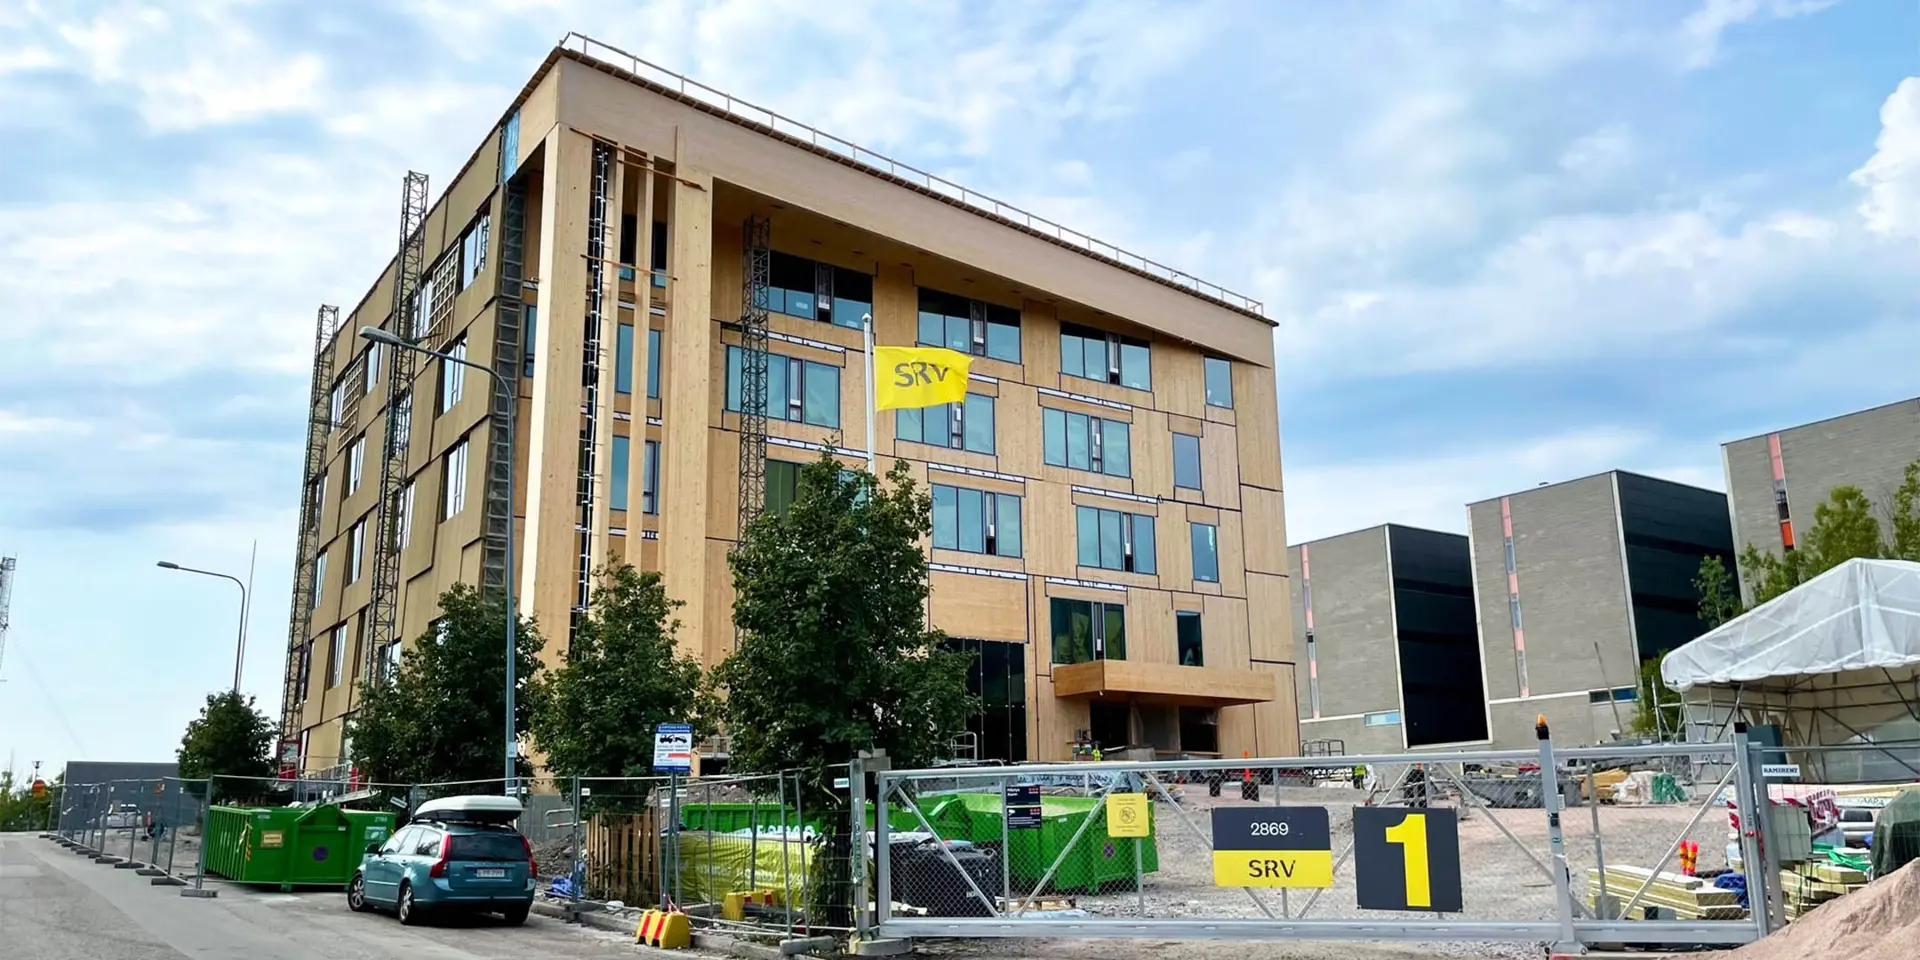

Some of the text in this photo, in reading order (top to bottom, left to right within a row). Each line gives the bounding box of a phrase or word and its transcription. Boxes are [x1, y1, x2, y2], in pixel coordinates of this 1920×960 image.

[894, 361, 949, 387] SRV
[1250, 822, 1289, 836] 2869
[1248, 859, 1296, 878] SRV
[1385, 813, 1431, 907] 1
